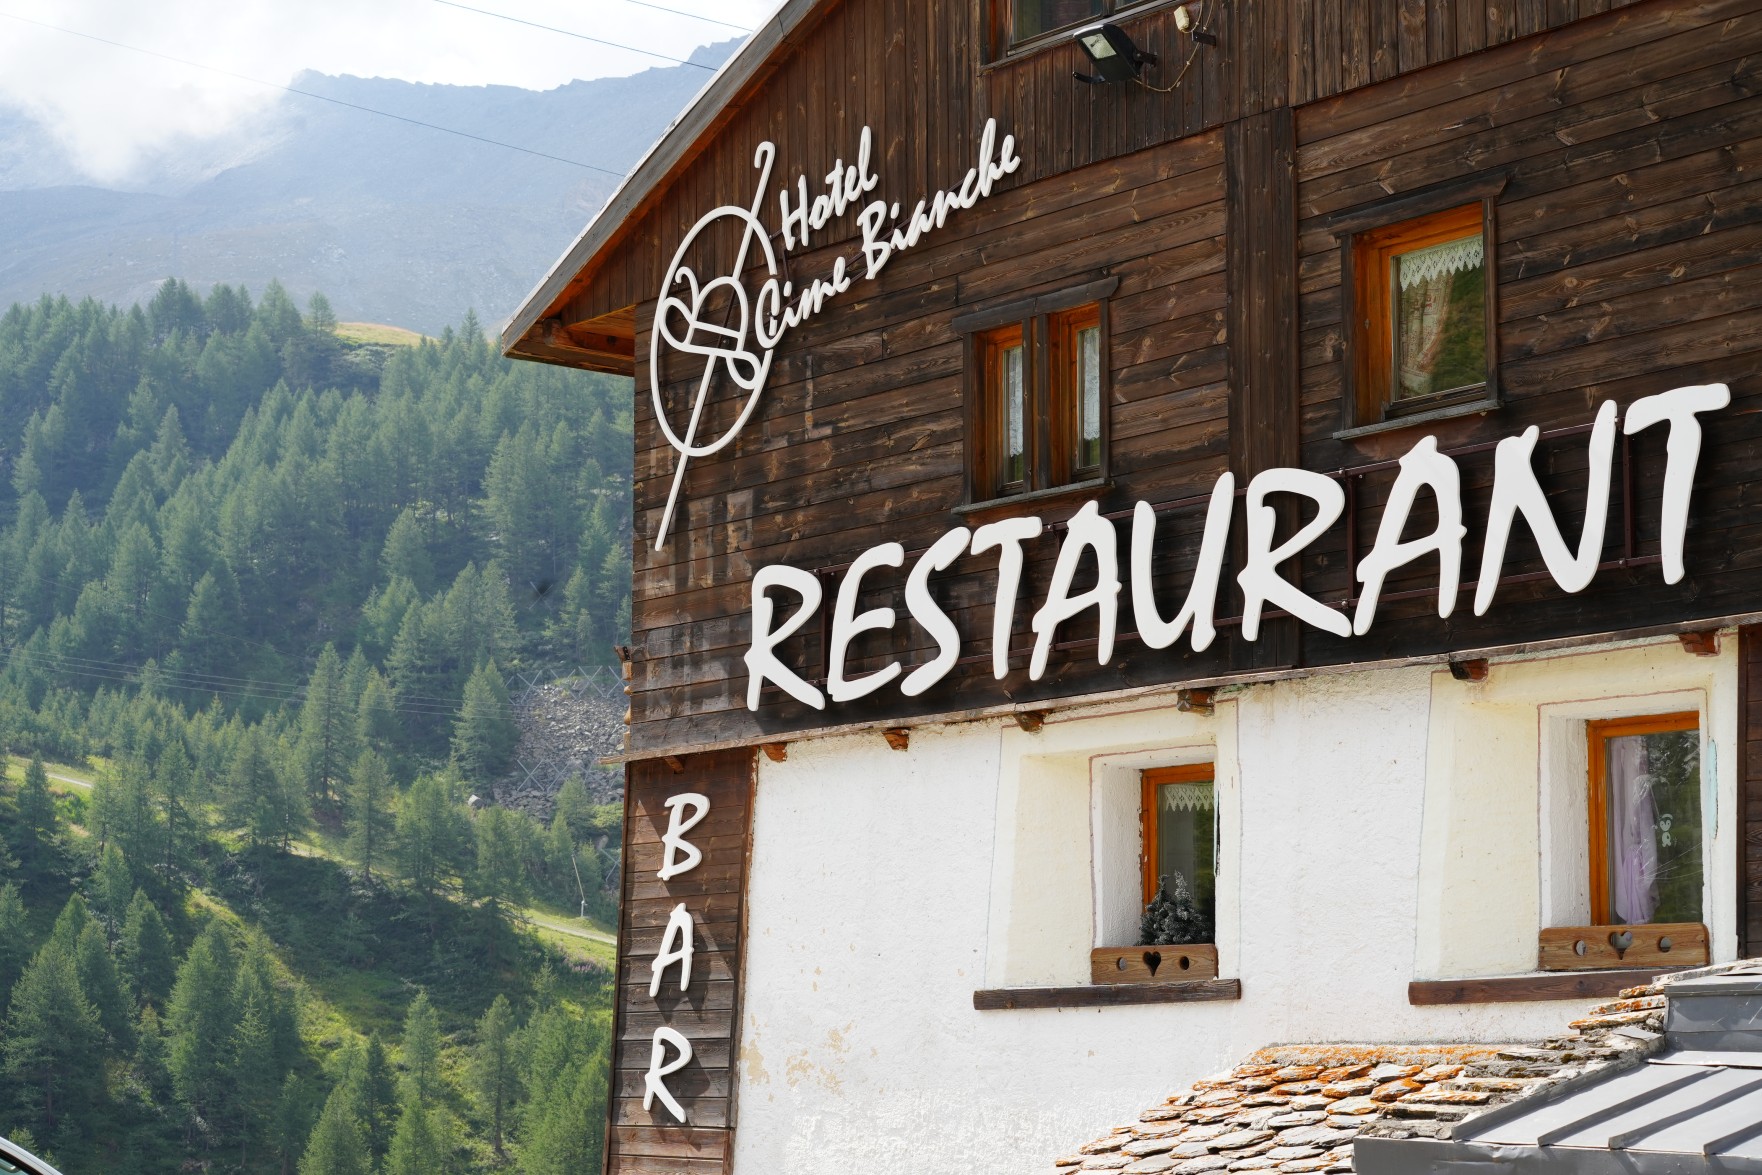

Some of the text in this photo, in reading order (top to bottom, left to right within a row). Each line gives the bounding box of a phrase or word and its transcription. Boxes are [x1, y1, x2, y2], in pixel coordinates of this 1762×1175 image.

[755, 117, 1021, 349] Cime Bianche
[780, 125, 878, 250] Hotel
[746, 382, 1731, 712] RESTAURANT
[643, 792, 711, 1124] BAR
